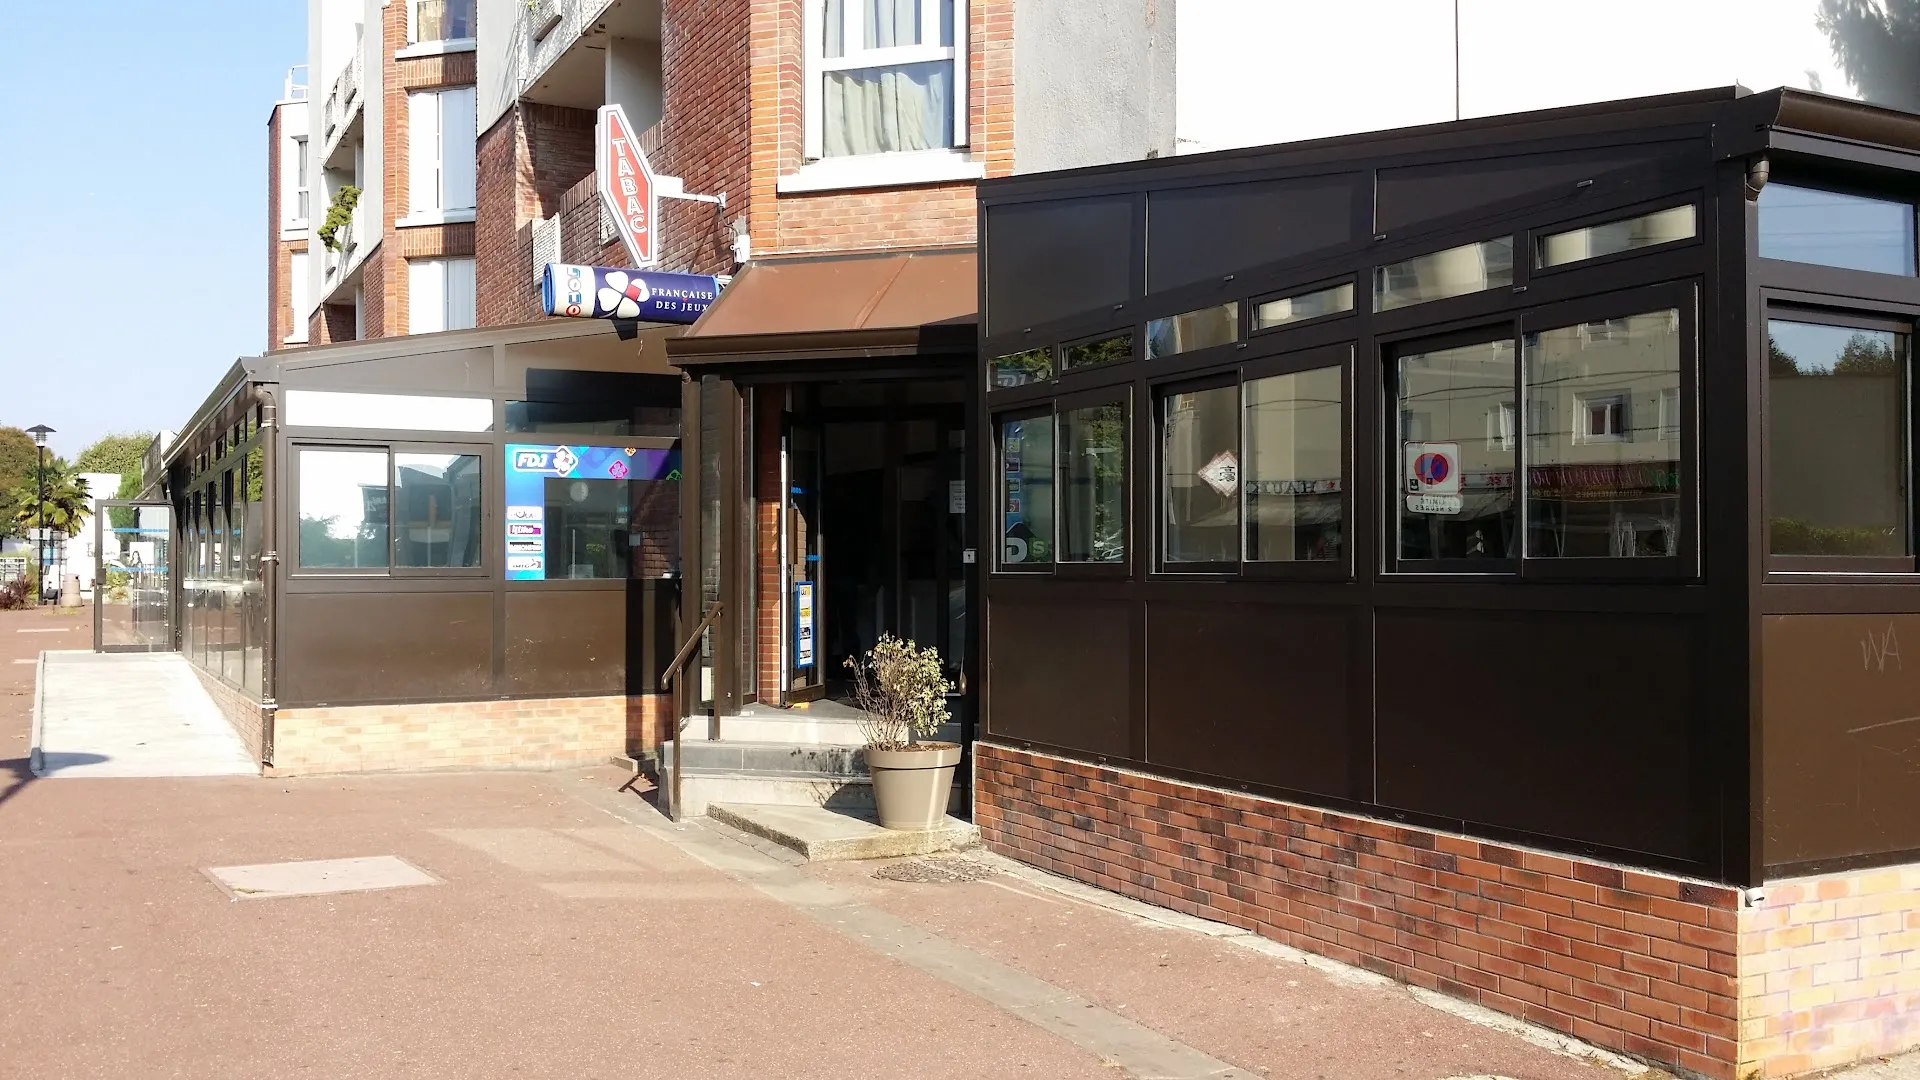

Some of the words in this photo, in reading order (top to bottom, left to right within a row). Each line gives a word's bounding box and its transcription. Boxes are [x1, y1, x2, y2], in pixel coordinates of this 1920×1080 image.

[611, 138, 648, 233] TABAC
[566, 267, 582, 317] LOTO
[651, 288, 713, 301] FRANÇAISE
[655, 301, 677, 310] DES
[681, 302, 709, 312] JEUX
[518, 453, 548, 467] FDJ
